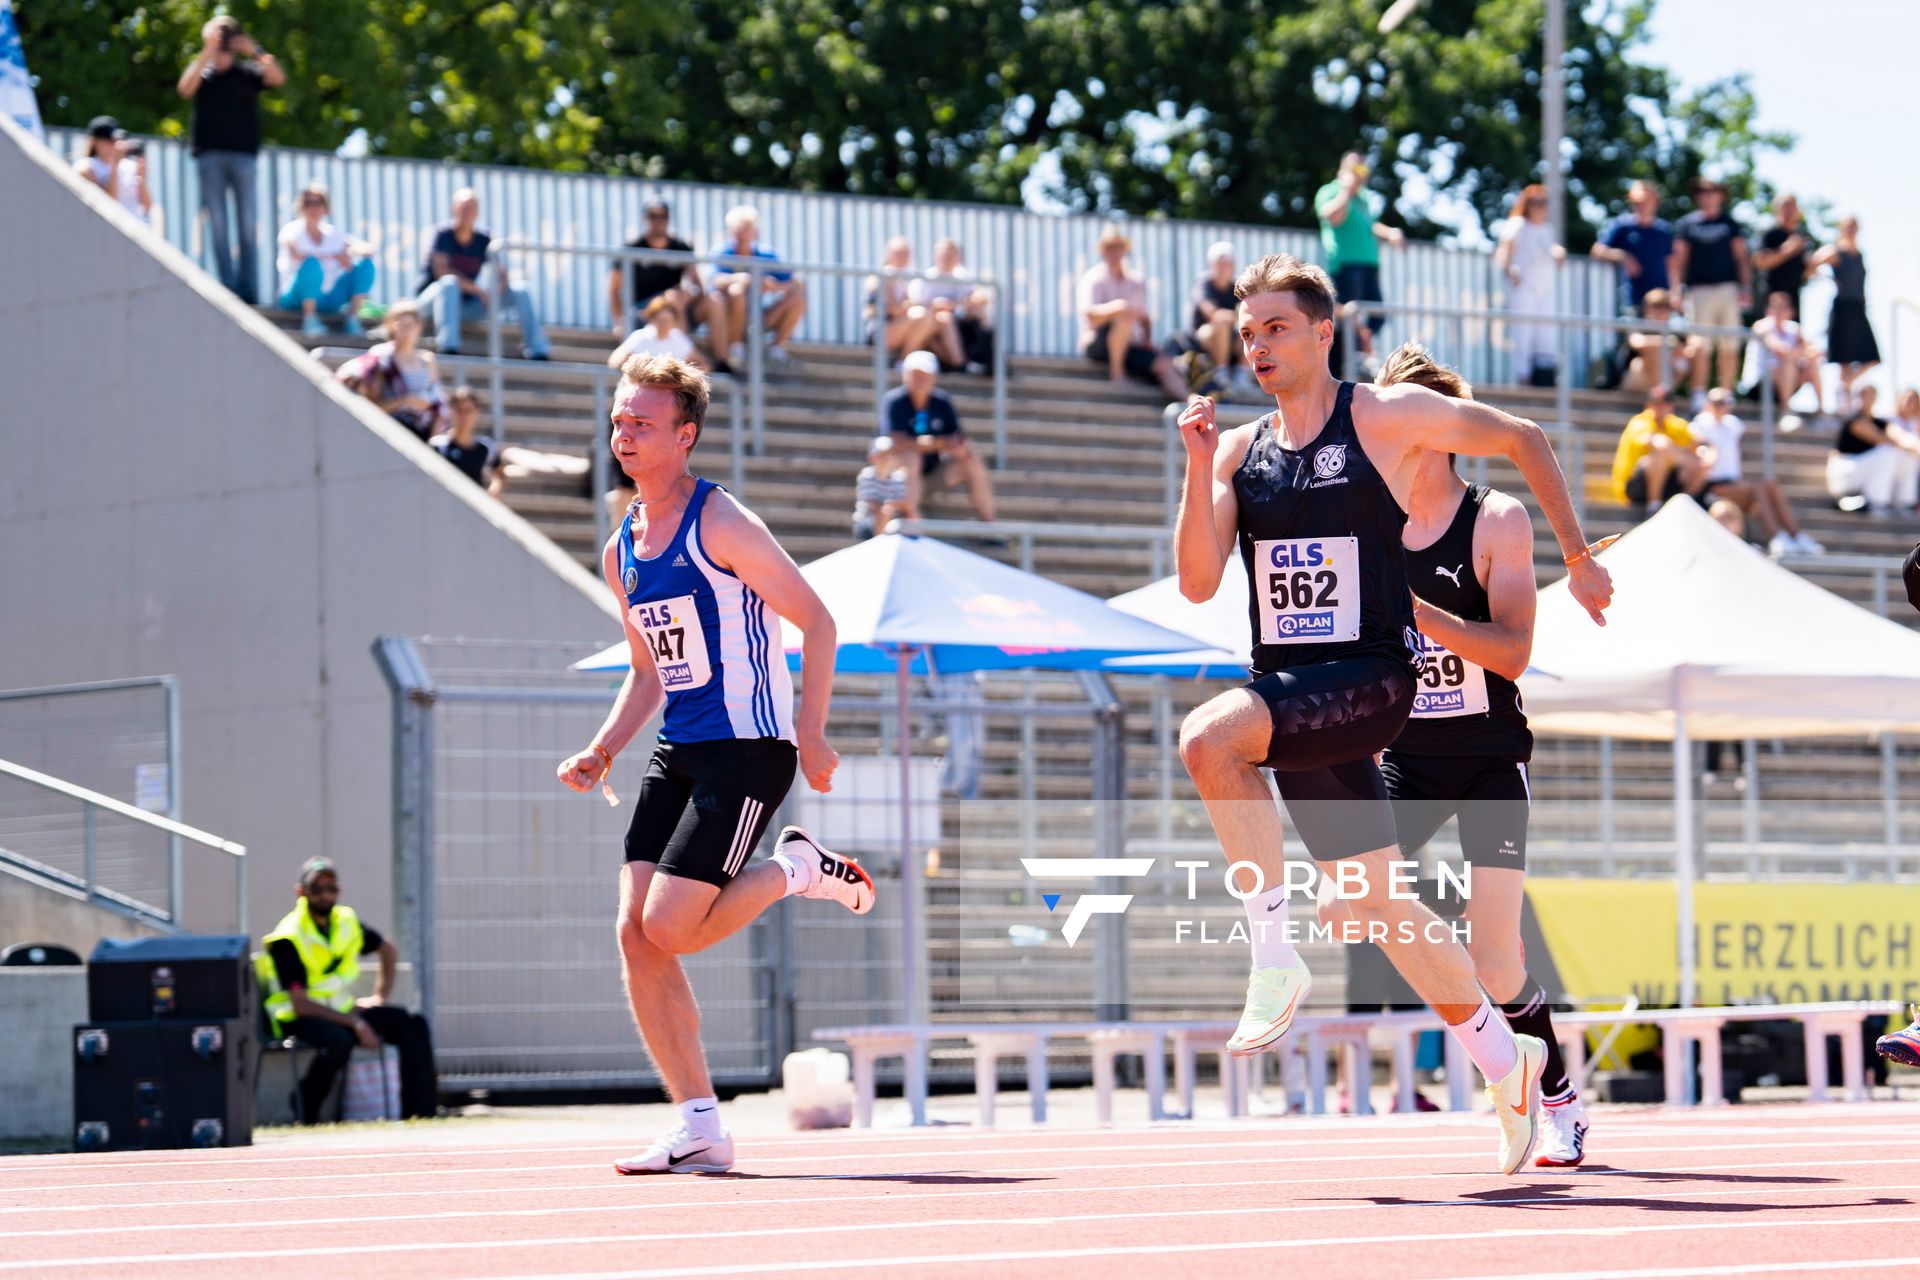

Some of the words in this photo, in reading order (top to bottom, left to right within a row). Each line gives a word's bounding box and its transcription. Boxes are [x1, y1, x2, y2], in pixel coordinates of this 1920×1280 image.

[1313, 444, 1347, 478] 96
[1310, 477, 1349, 489] Leichtathletik
[1270, 542, 1334, 569] GLS.
[1269, 570, 1339, 610] 562
[638, 604, 679, 629] GLS.
[1298, 616, 1331, 628] PLAN
[668, 666, 690, 679] PLAN
[1430, 693, 1461, 705] PLAN
